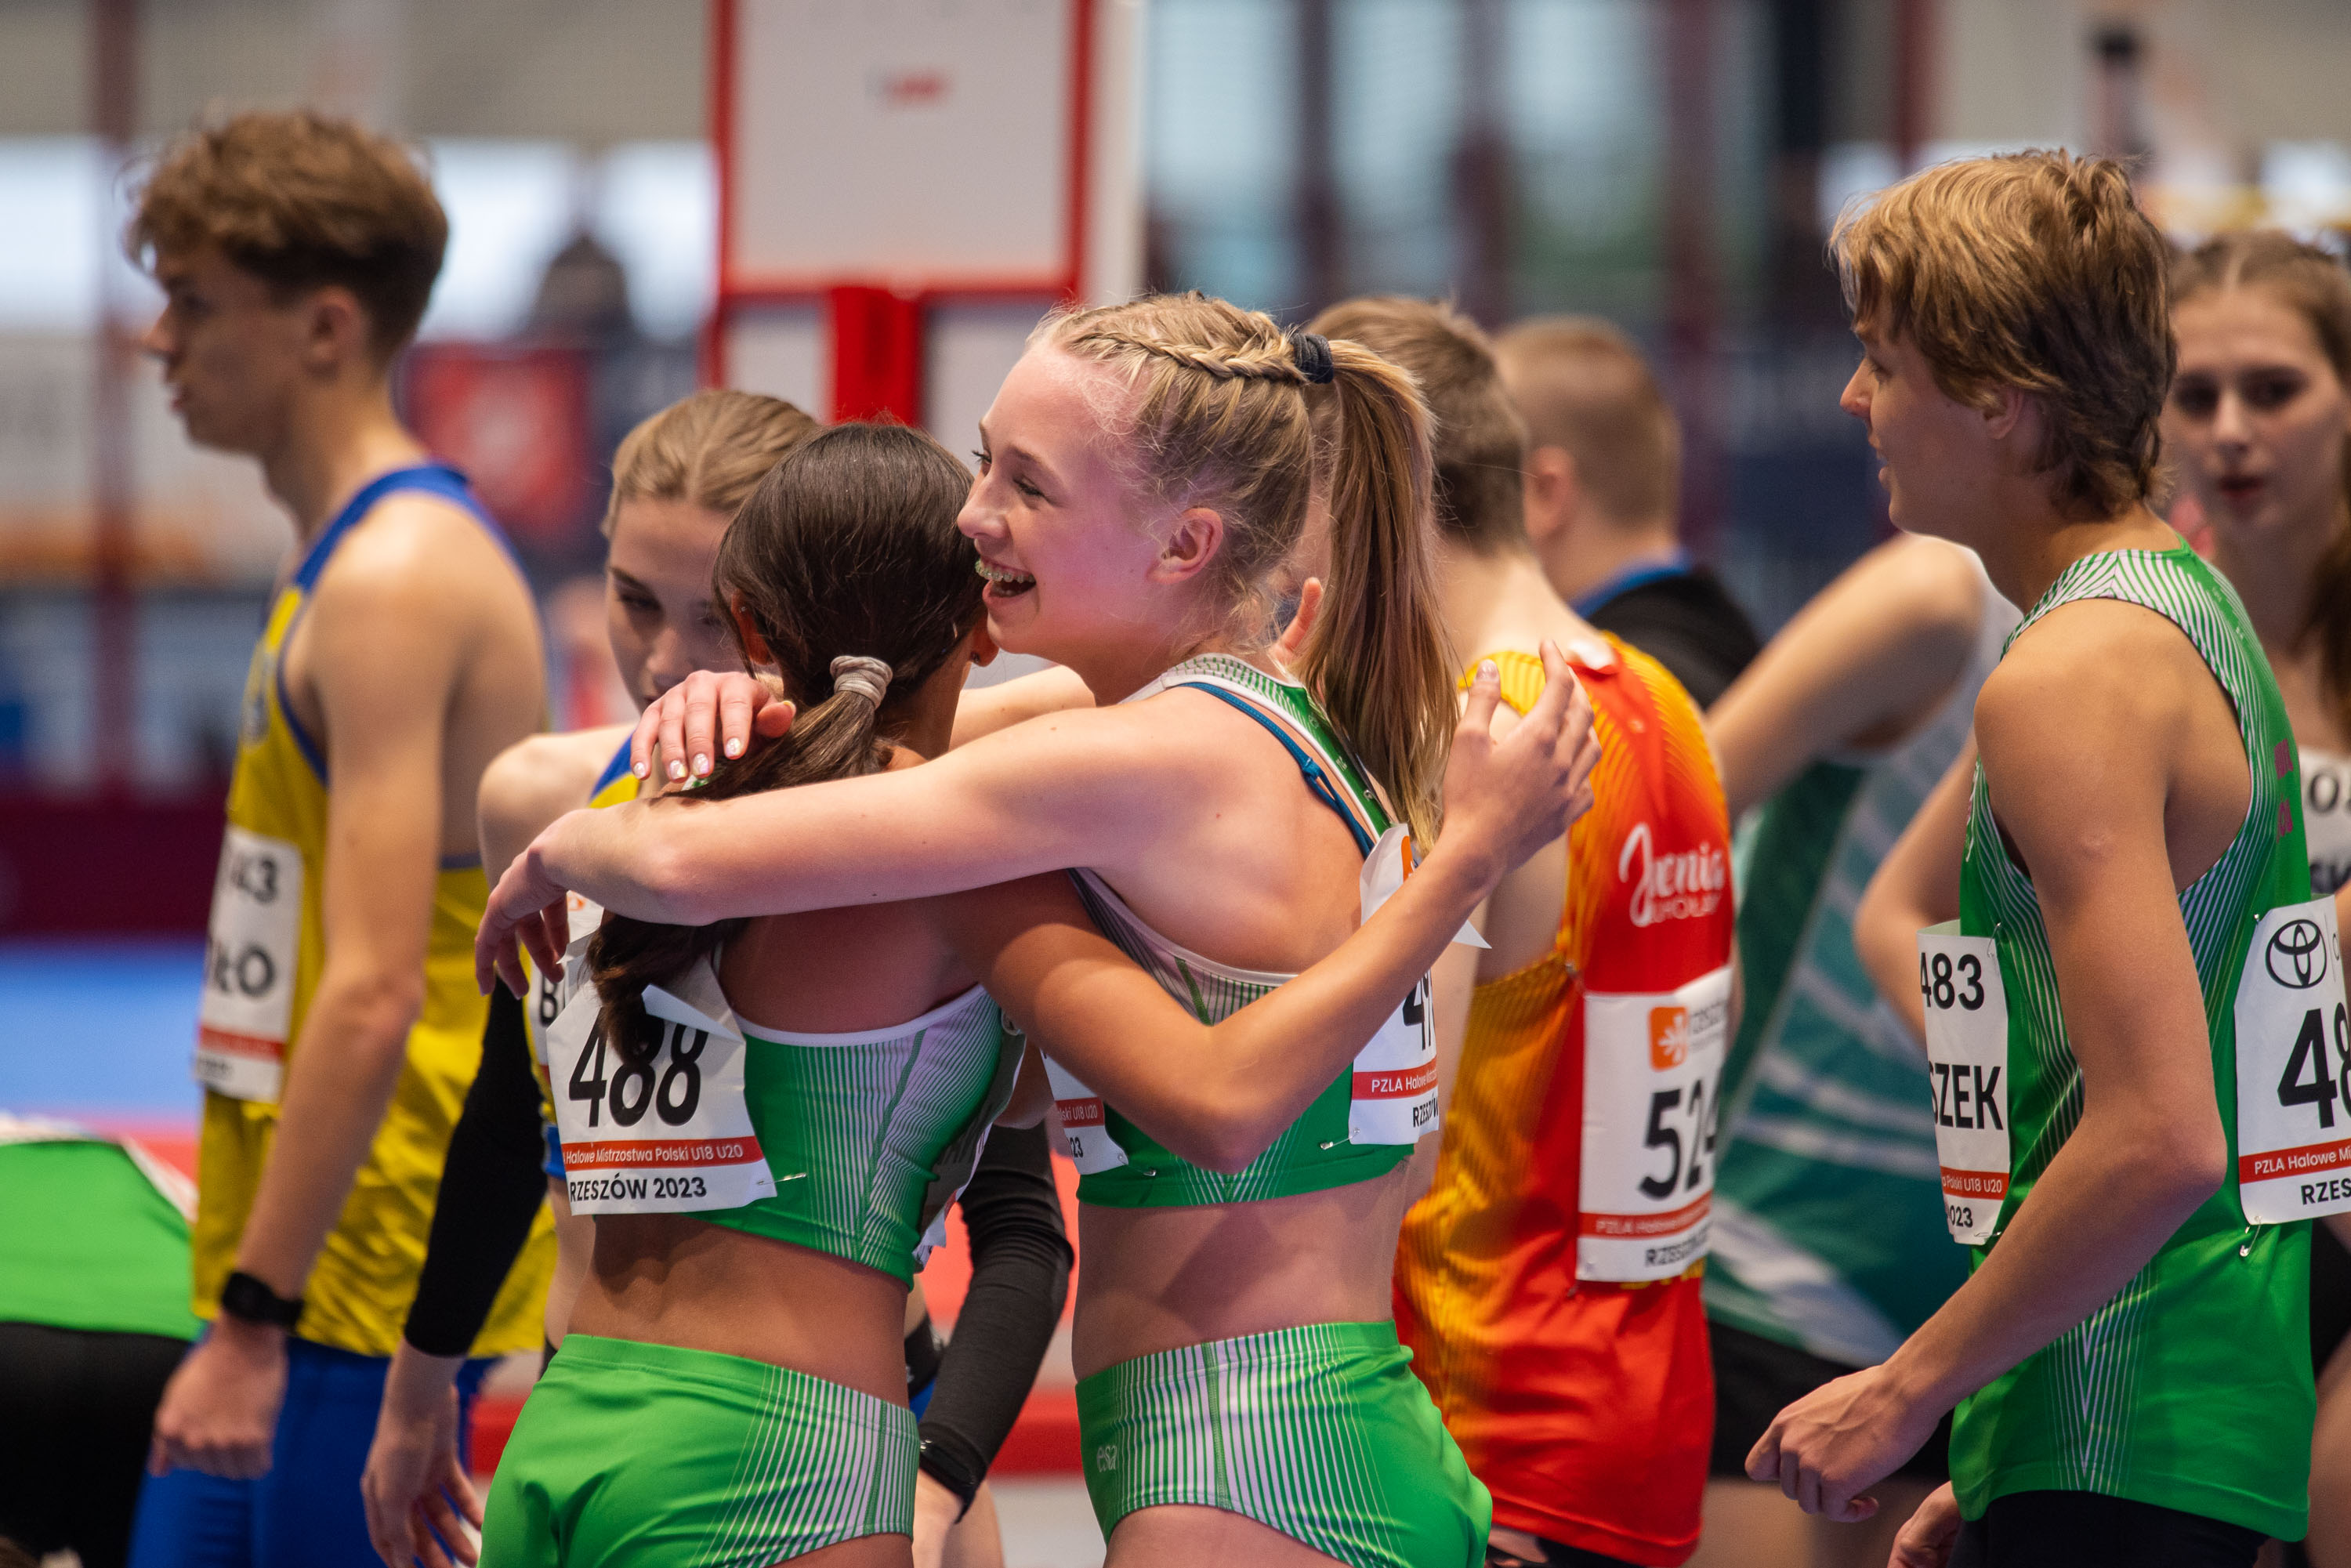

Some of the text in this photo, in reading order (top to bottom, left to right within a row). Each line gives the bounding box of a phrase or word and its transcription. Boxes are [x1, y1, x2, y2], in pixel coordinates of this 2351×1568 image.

[1920, 952, 1985, 1010] 483
[569, 1011, 708, 1128] 488
[1371, 1077, 1403, 1093] PZLA
[1073, 1106, 1085, 1121] U18
[1085, 1104, 1098, 1120] U20
[566, 1144, 744, 1165] Halowe Mistrzostwa Polski U18 U20
[2254, 1157, 2285, 1175] PZLA
[2288, 1151, 2337, 1169] Halowe
[570, 1172, 707, 1203] RZESZÓW 2023
[1963, 1177, 1981, 1192] U18
[1983, 1179, 2002, 1193] U20
[1948, 1204, 1973, 1228] 023
